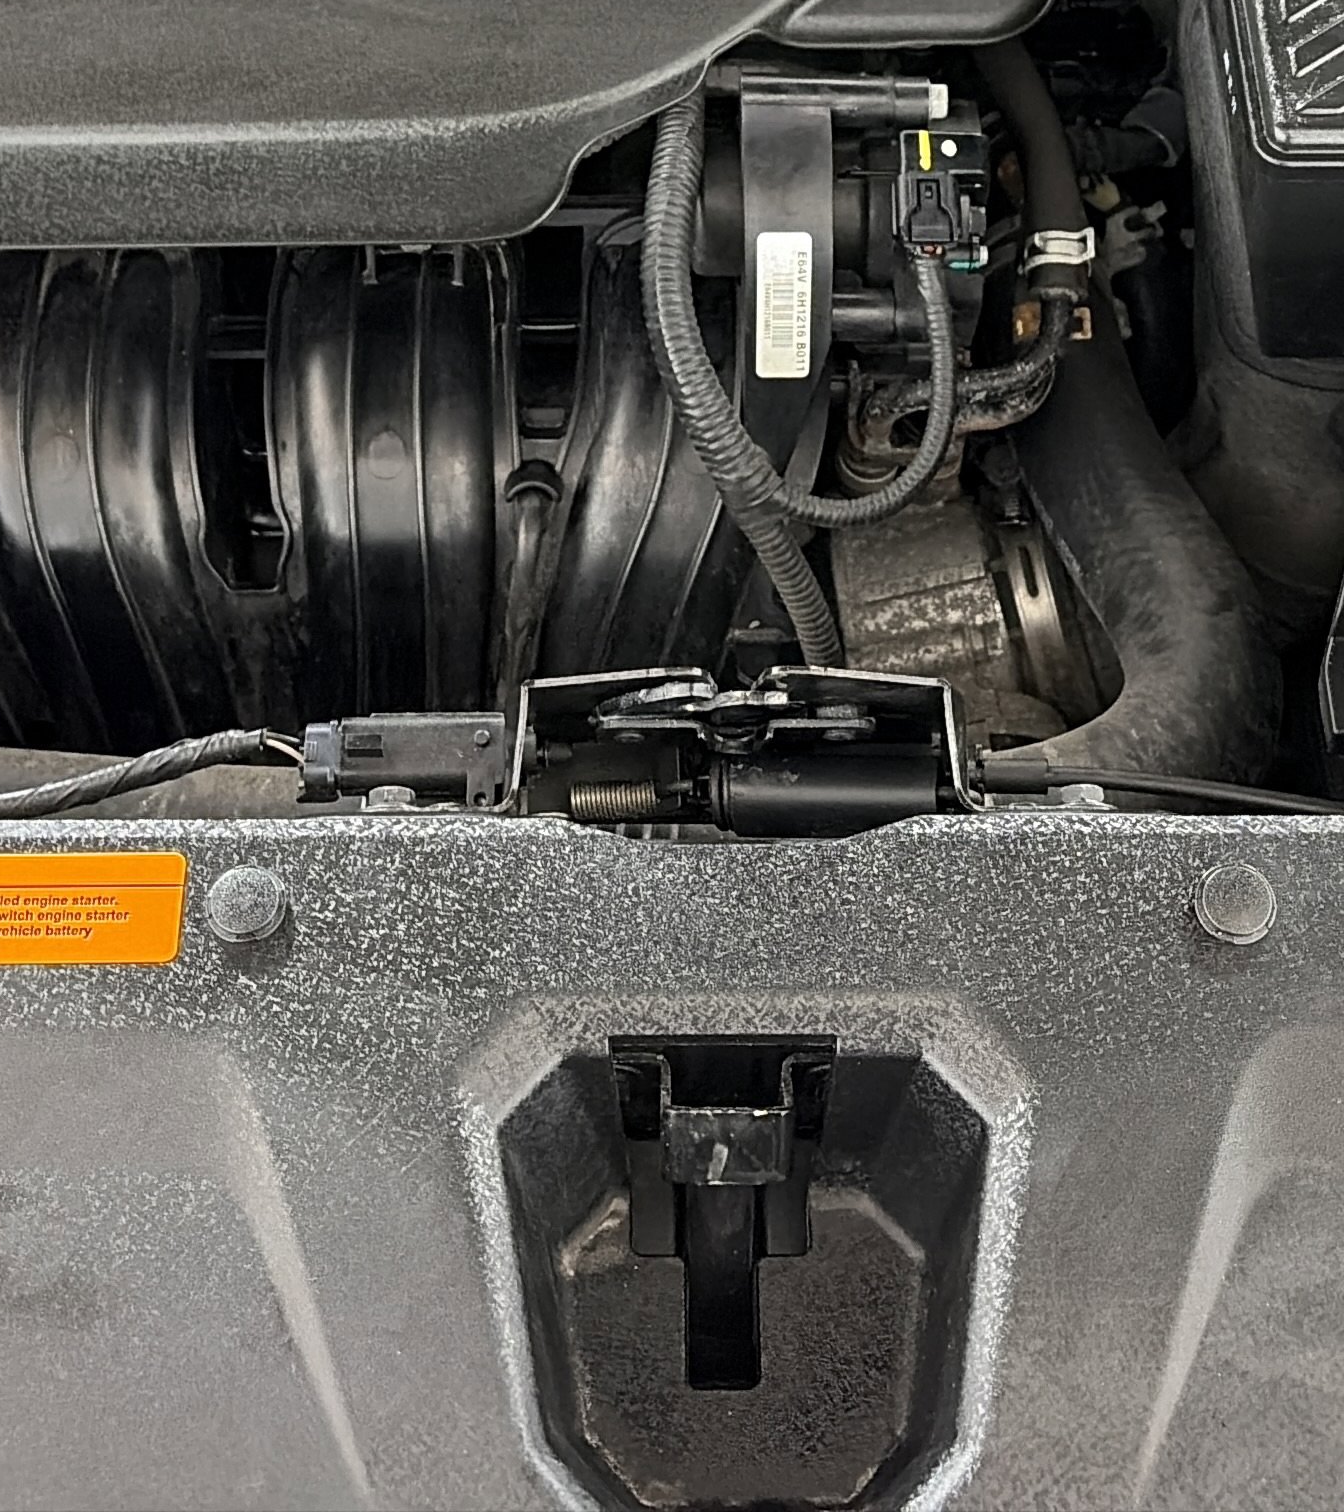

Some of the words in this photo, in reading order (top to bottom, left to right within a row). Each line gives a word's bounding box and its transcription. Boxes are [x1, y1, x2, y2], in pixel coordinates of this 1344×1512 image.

[797, 251, 808, 283] E64V
[796, 291, 808, 338] 6H1216
[795, 342, 807, 372] B011
[23, 895, 68, 908] engine
[71, 895, 119, 905] starter.
[37, 910, 82, 923] engine
[85, 910, 130, 921] starter
[45, 925, 92, 939] battery
